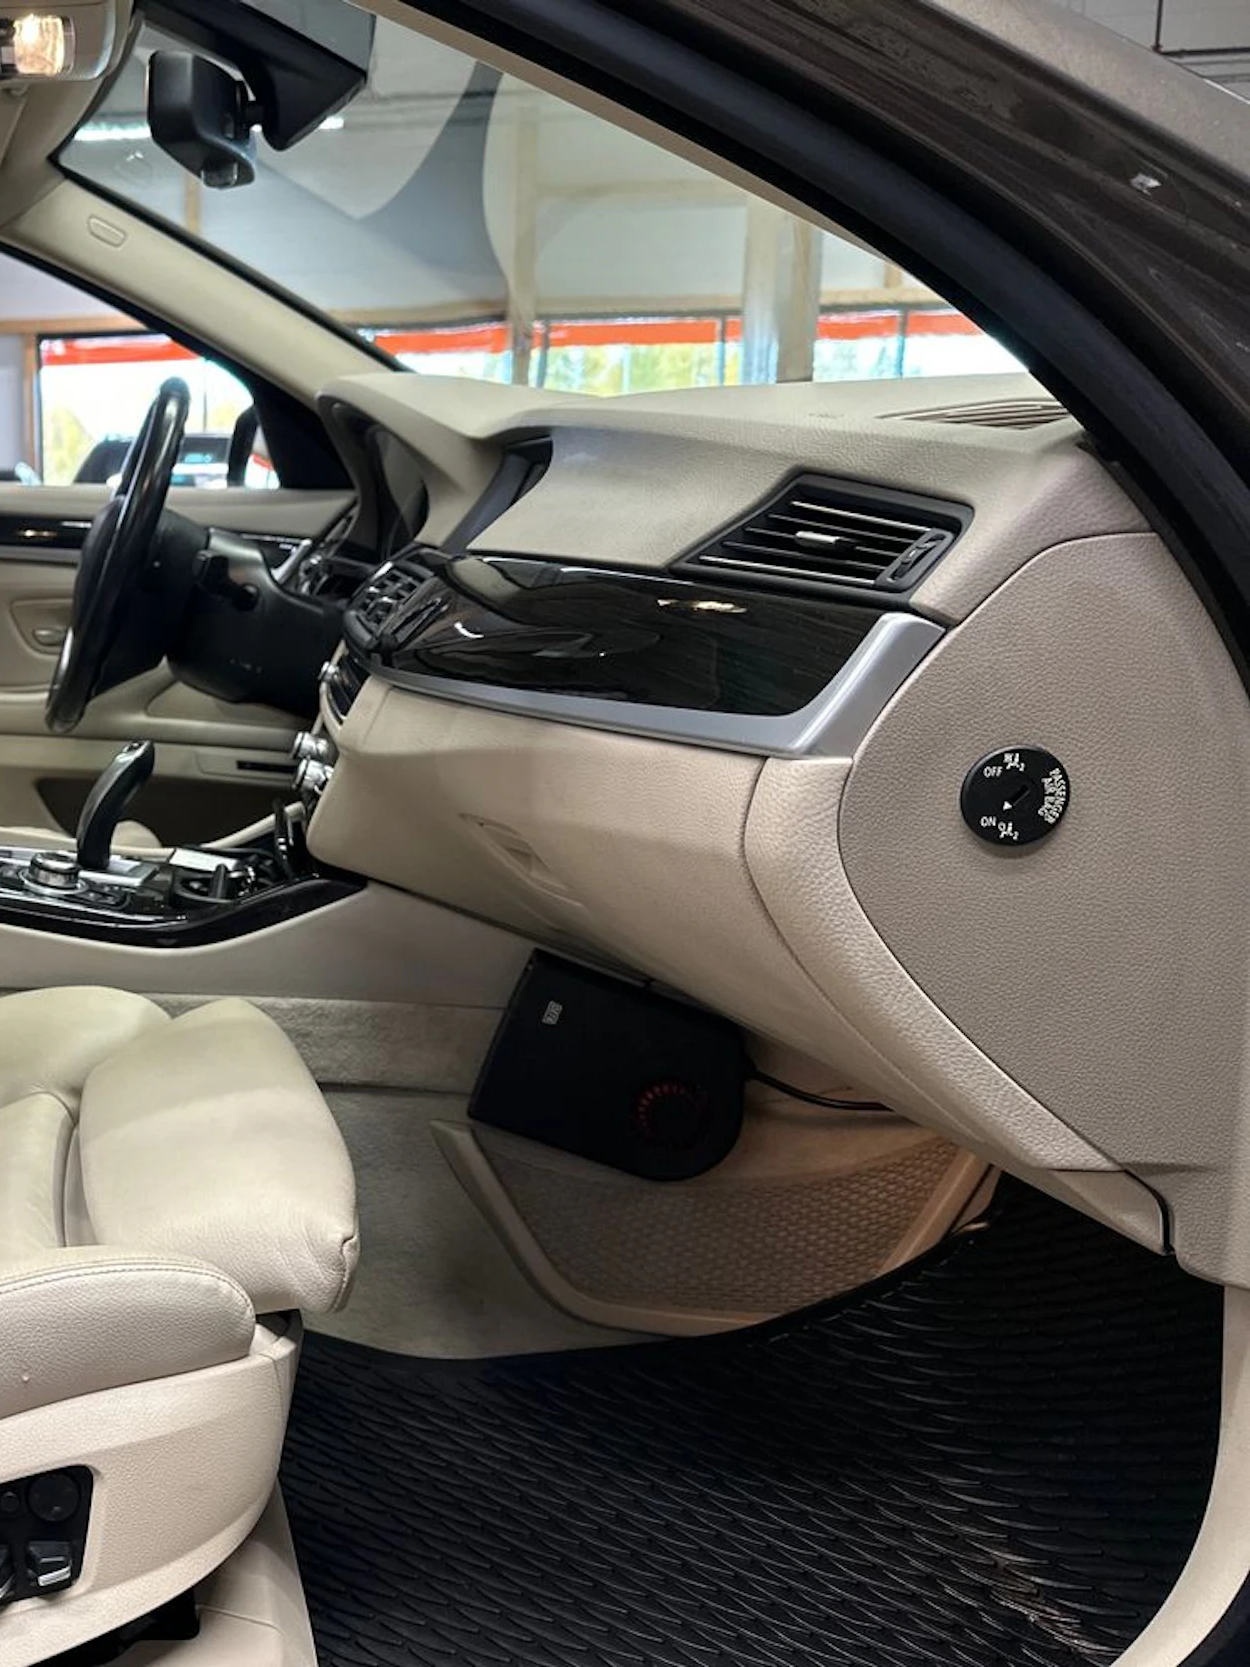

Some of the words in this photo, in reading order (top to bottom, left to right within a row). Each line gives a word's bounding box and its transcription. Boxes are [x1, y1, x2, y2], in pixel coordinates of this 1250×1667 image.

[983, 766, 1002, 778] OFF
[1044, 768, 1066, 824] PASSENGER
[980, 816, 996, 828] ON
